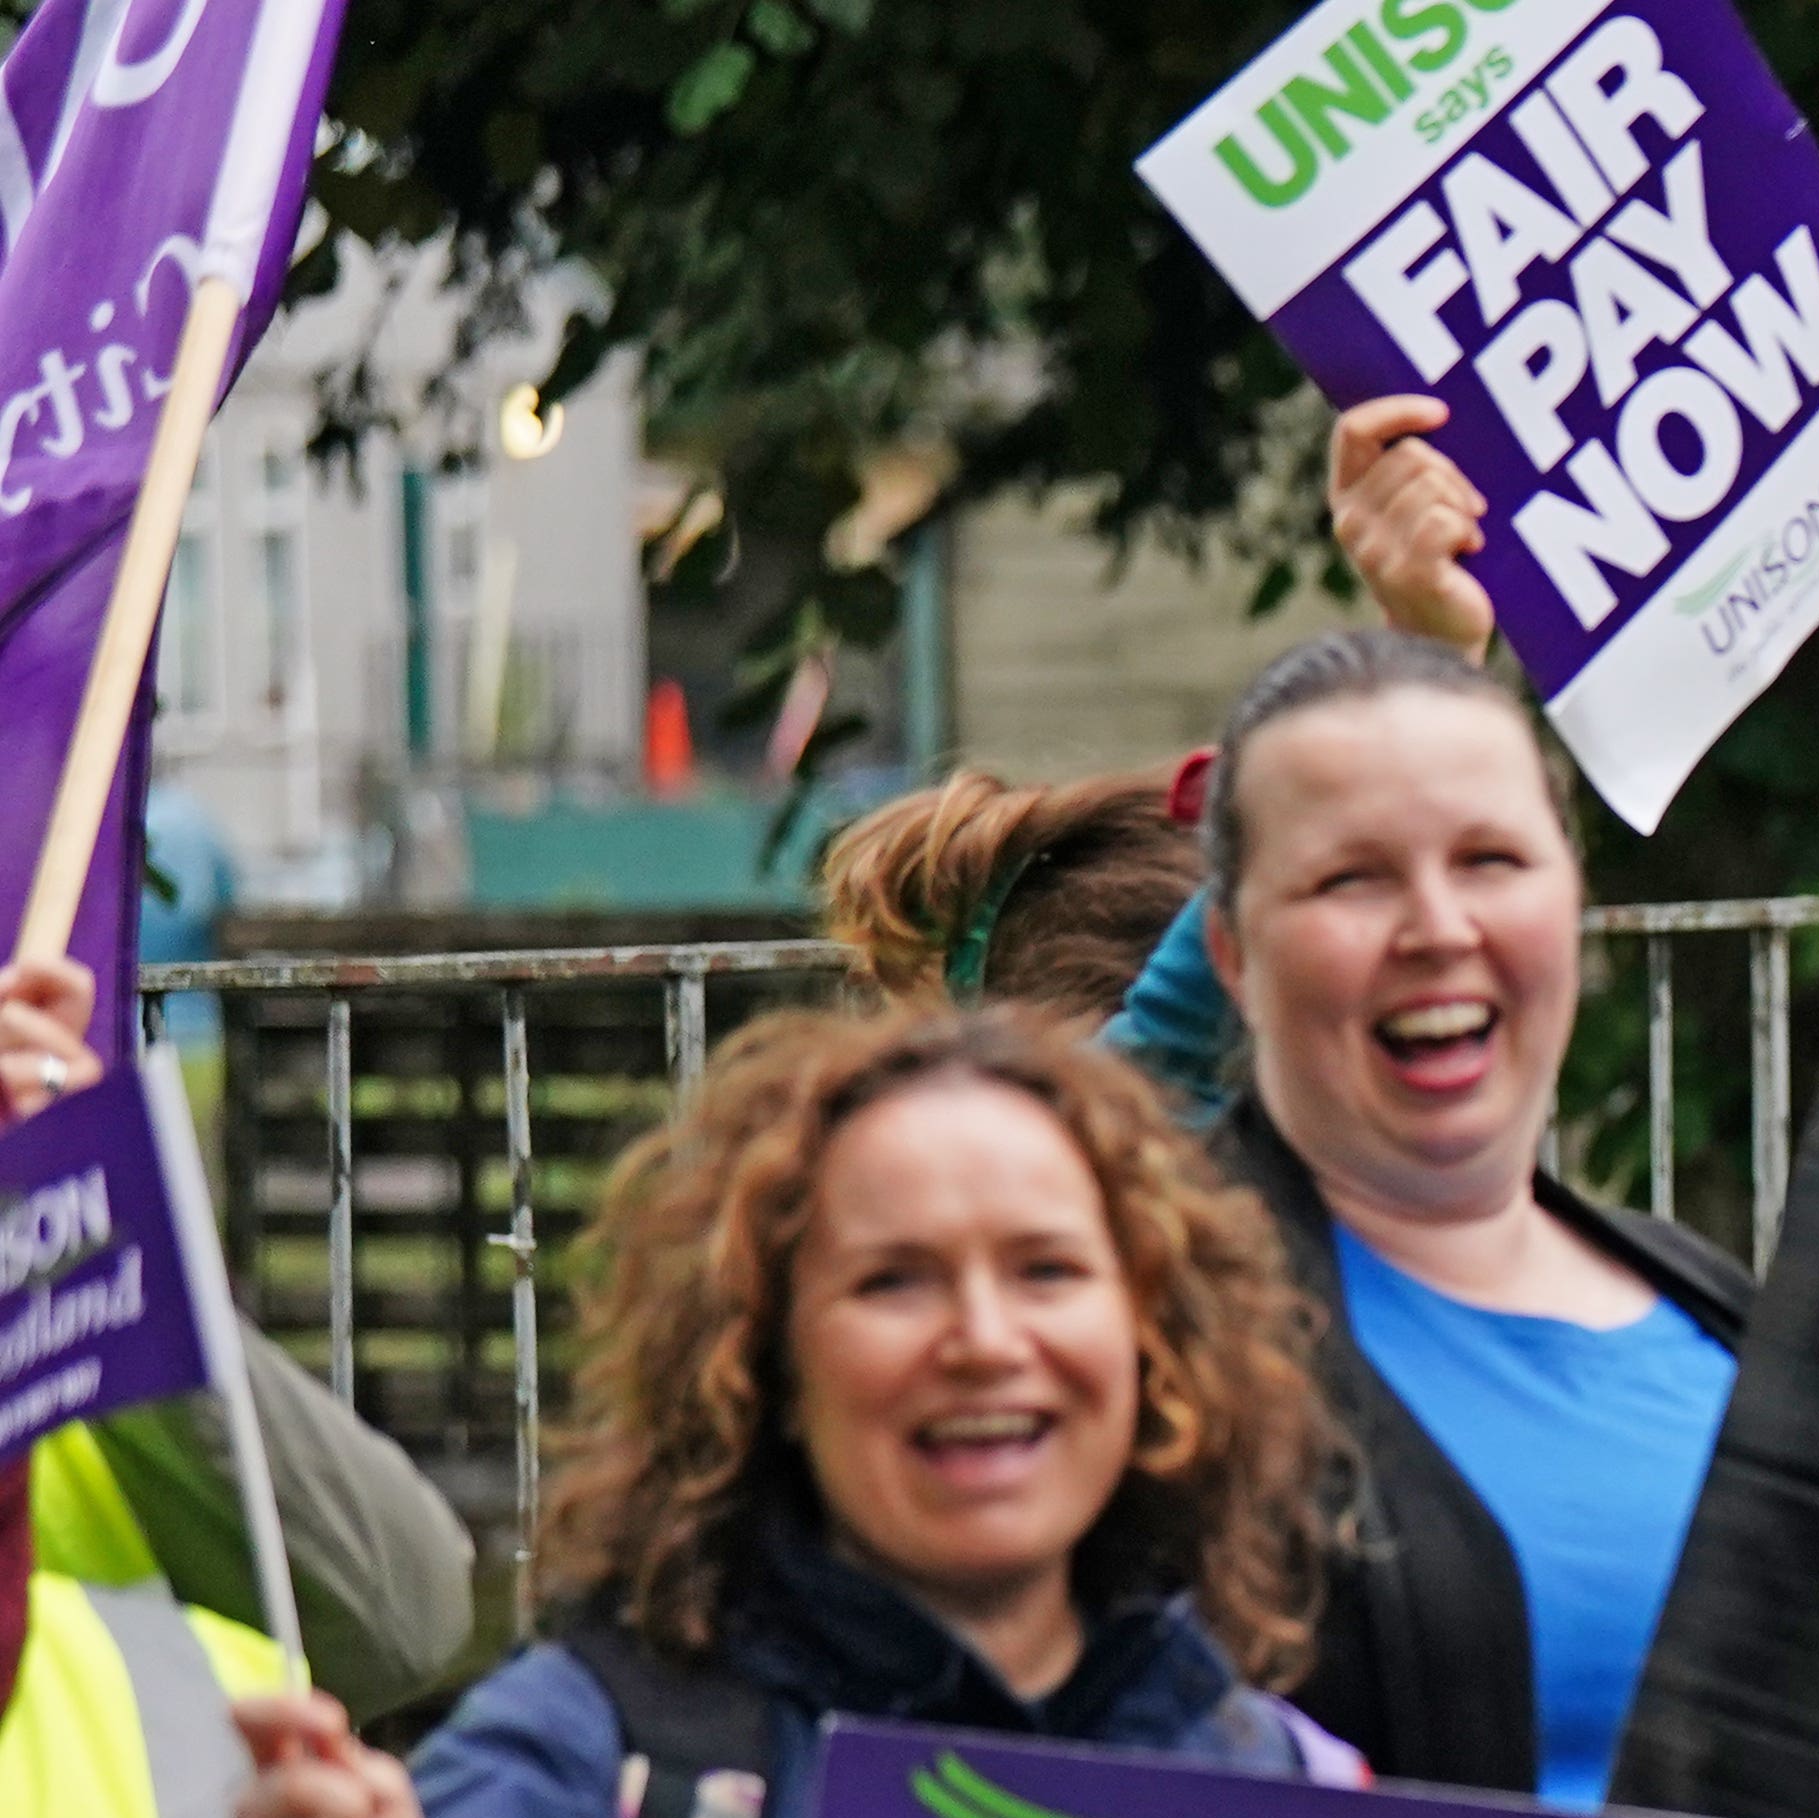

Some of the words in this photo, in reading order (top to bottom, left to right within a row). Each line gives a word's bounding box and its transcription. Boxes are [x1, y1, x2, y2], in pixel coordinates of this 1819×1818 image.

[1213, 0, 1521, 210] UNIS
[1342, 14, 1705, 385] FAIR
[1412, 42, 1515, 145] says
[1473, 139, 1733, 474] PAY
